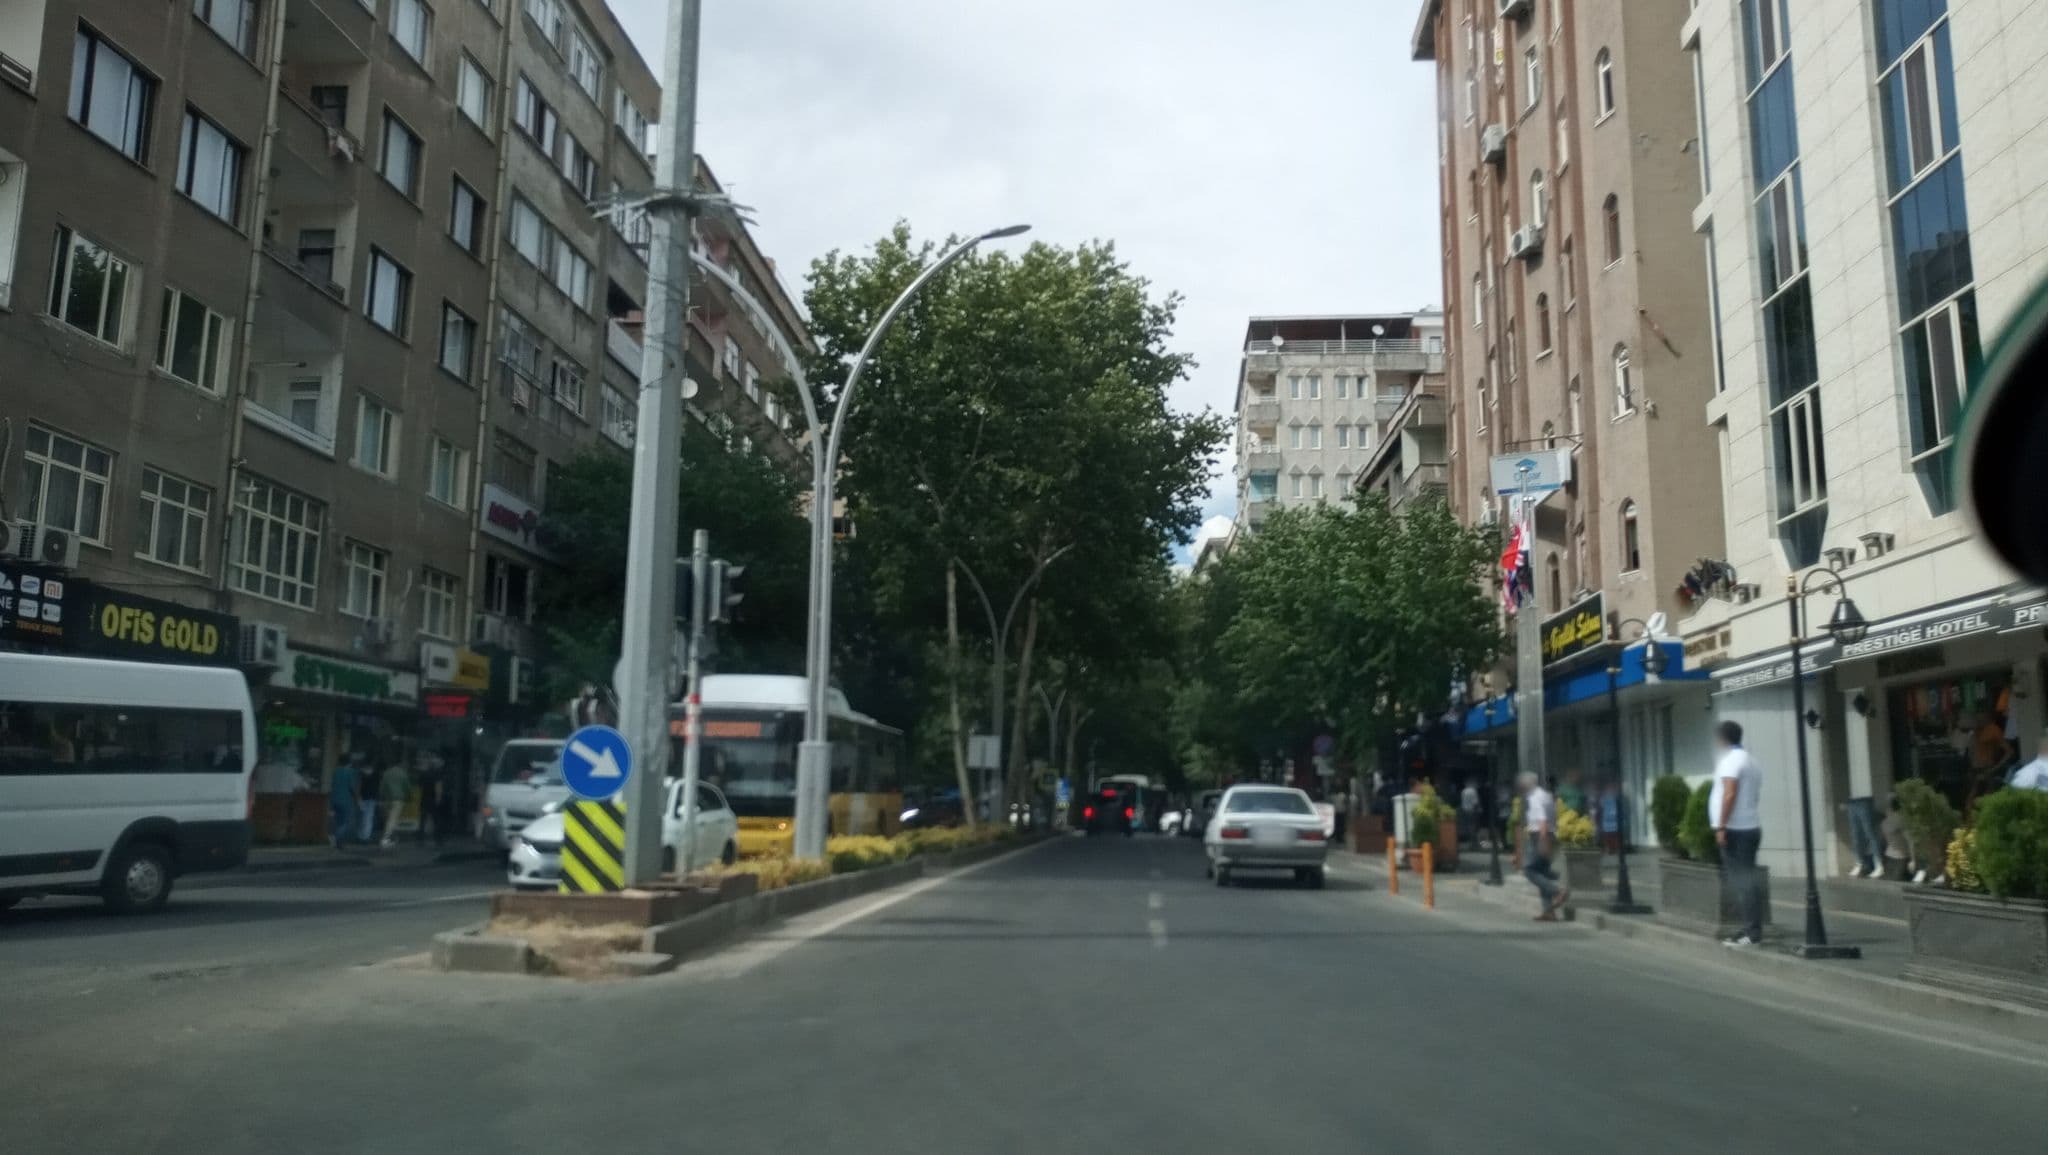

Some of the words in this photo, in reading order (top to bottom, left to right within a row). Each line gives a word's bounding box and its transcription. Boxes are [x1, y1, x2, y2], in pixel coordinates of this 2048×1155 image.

[160, 615, 219, 655] GOLD
[1842, 629, 1922, 657] PRESTIGE
[1925, 615, 1990, 638] HOTEL
[1721, 668, 1774, 691] PRESTIGE
[1776, 656, 1818, 677] HOEL
